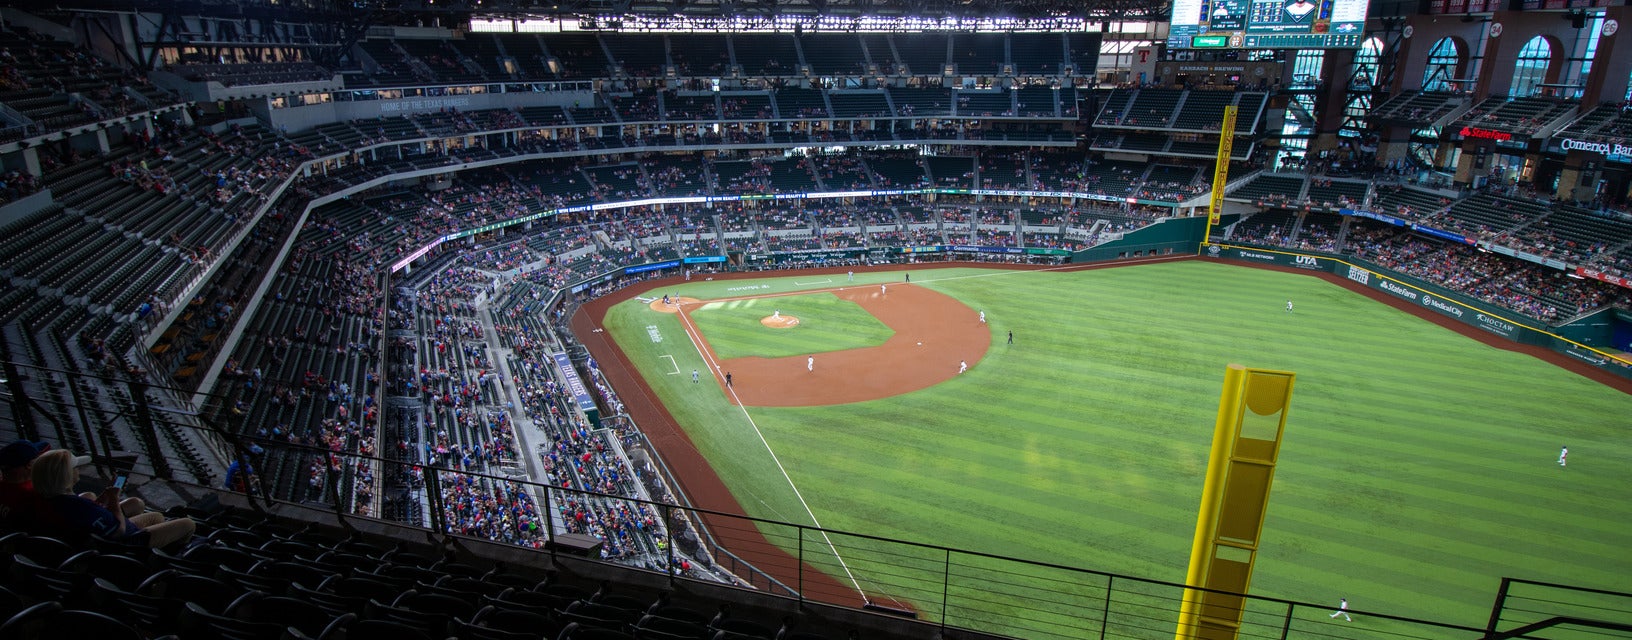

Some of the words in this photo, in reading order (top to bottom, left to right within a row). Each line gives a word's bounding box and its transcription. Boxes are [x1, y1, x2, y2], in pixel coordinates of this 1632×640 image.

[1492, 26, 1501, 35] 34
[1604, 23, 1617, 34] 26
[1138, 50, 1150, 62] T
[381, 102, 400, 111] HOME
[402, 102, 410, 110] OF
[412, 101, 423, 109] THE
[424, 100, 442, 108] TEXAS
[444, 98, 469, 107] RANGERS
[1296, 256, 1317, 266] UTA
[1480, 314, 1514, 332] CHOCTAW
[561, 364, 576, 378] TEXAS
[568, 377, 586, 396] RANGERS
